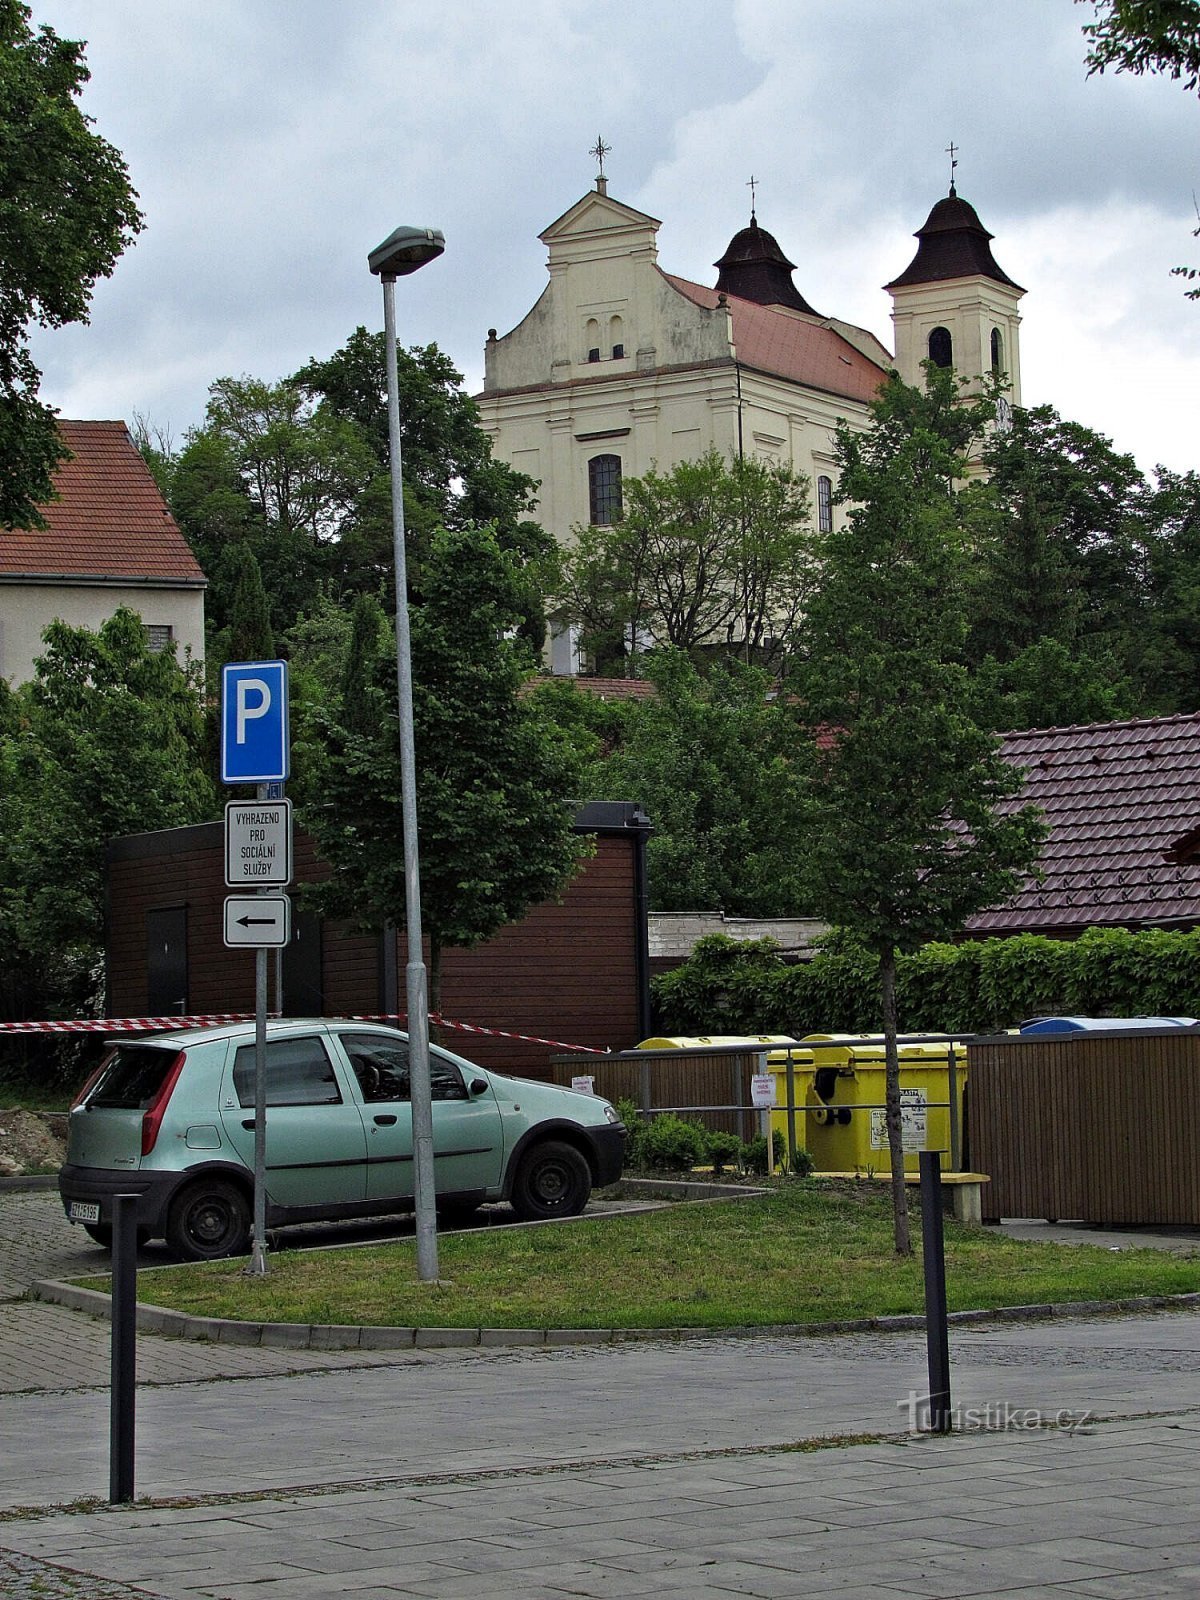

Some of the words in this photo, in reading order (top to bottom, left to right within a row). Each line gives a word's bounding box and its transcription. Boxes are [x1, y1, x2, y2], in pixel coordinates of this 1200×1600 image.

[236, 678, 271, 744] P
[236, 812, 280, 825] VYHRAZENO
[249, 829, 265, 841] PRO
[240, 843, 276, 859] SOCIÁLNÍ
[243, 860, 272, 876] SLUŽBY
